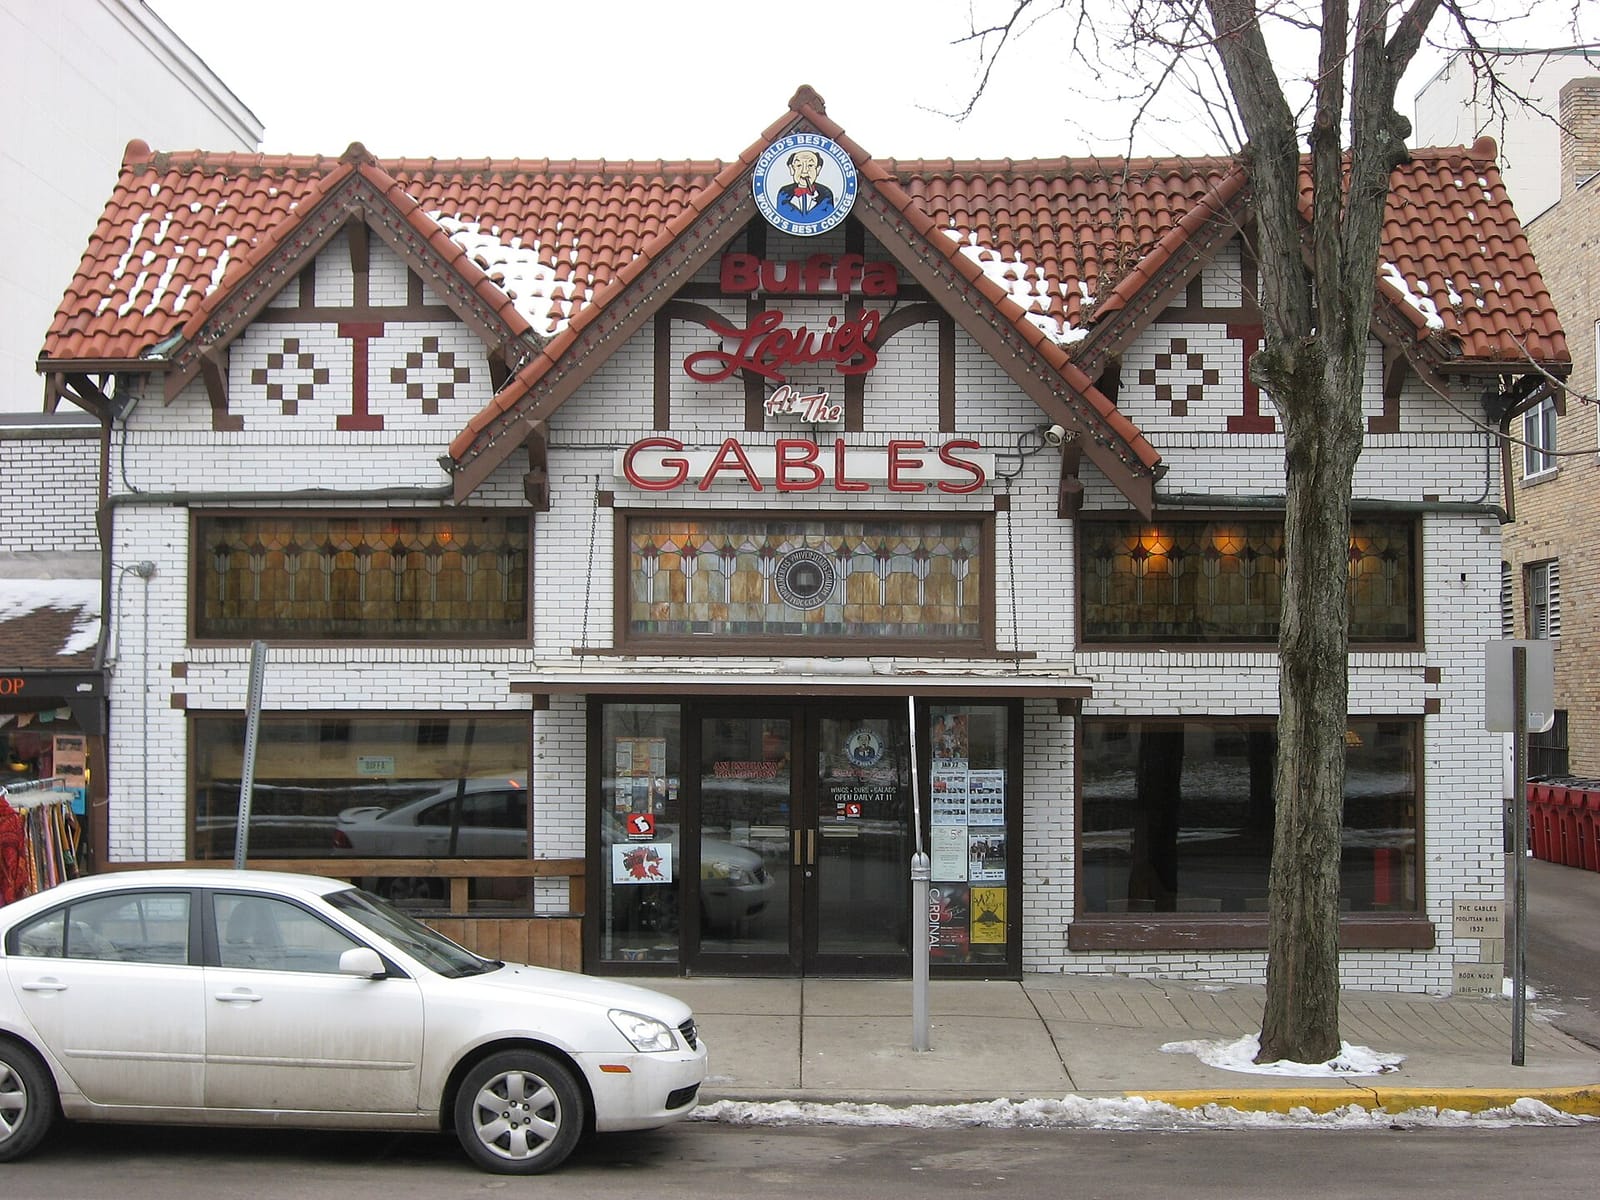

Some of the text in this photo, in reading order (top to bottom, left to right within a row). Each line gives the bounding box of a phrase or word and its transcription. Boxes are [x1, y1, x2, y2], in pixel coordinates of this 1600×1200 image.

[756, 135, 854, 178] WORLD'S BEST WINGS
[756, 192, 854, 234] WORLD'S BEST COLLEGE
[721, 254, 898, 295] Buffa
[683, 308, 880, 382] Louie's
[764, 385, 843, 423] At The
[623, 436, 985, 493] GABLES
[929, 888, 940, 950] CARDINAL
